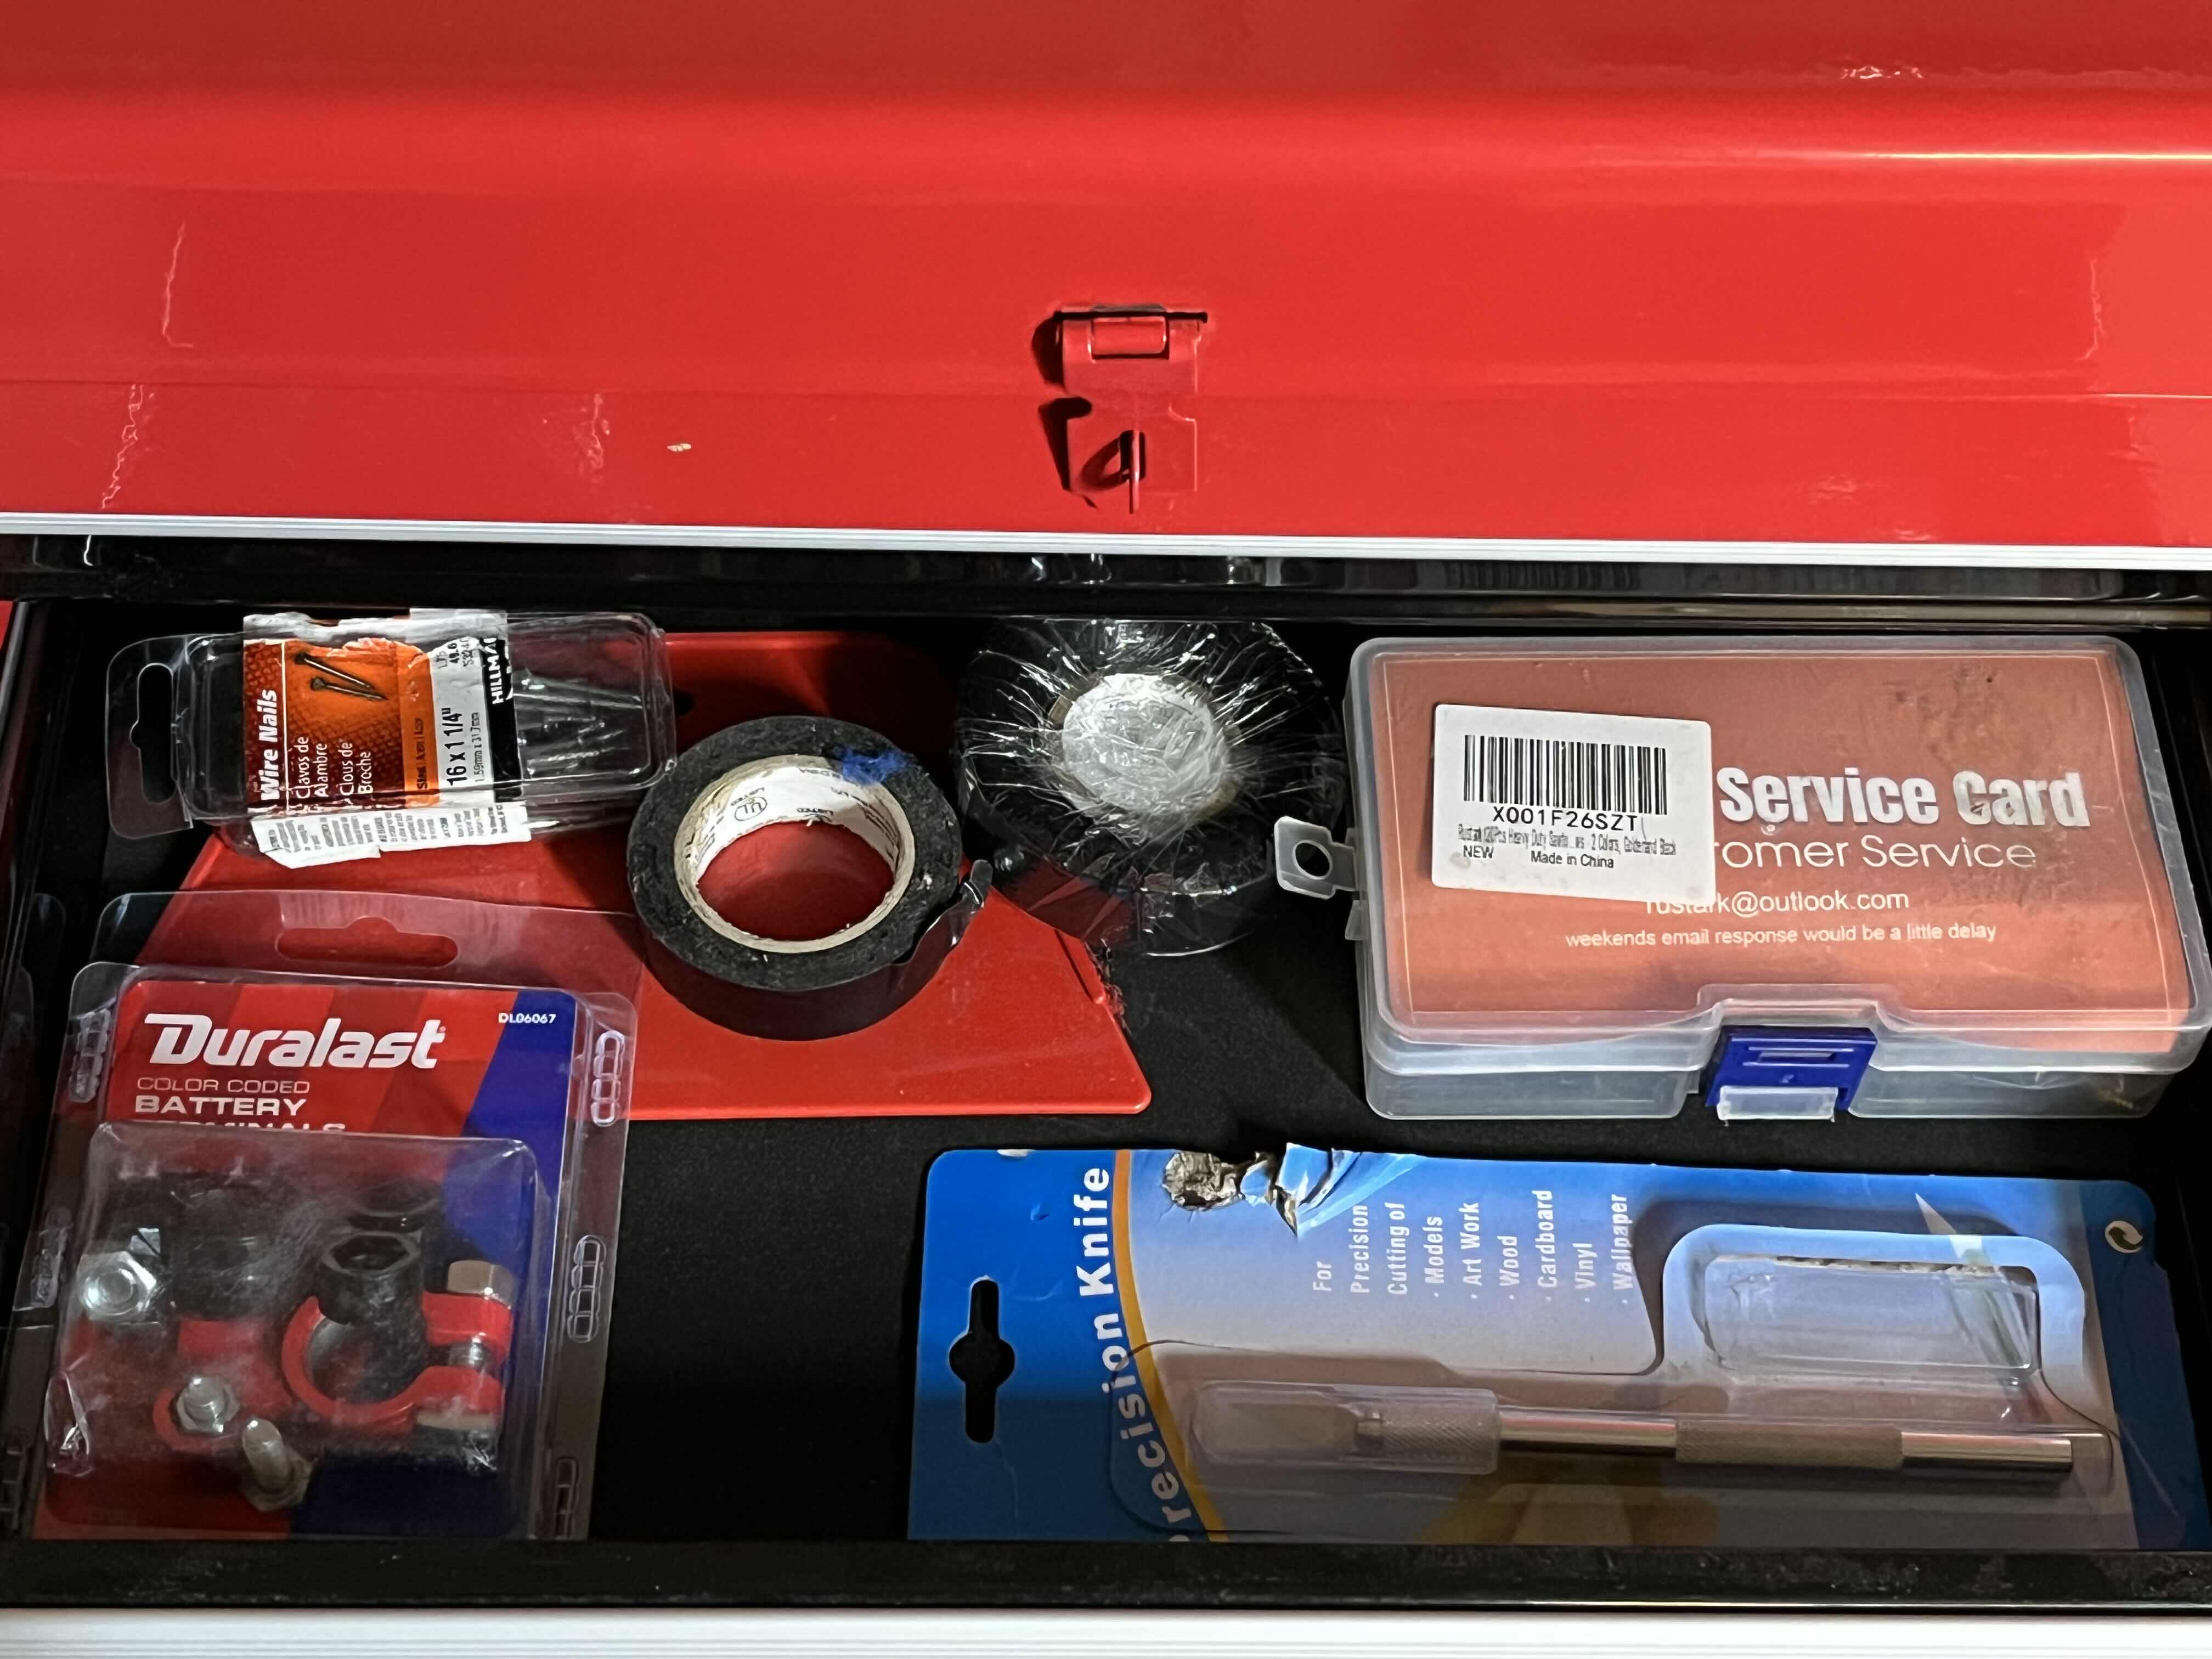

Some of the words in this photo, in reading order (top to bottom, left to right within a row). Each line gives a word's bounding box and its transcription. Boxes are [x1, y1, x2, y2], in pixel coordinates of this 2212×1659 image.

[256, 689, 278, 743] Nails
[441, 707, 464, 736] 1/4"
[294, 736, 309, 753] de
[337, 742, 353, 757] de
[444, 741, 465, 750] 1
[449, 752, 466, 762] x
[259, 749, 280, 800] Wire
[295, 756, 311, 799] Clavos
[312, 743, 329, 798] Alambre
[336, 761, 354, 796] Clous
[356, 751, 374, 794] Broche
[446, 765, 467, 786] 16
[1716, 767, 1940, 825] Service
[1953, 770, 2092, 828] Card
[1492, 805, 1638, 832] X001F26SZT
[1463, 845, 1494, 859] NEW
[1531, 850, 1562, 865] Made
[1567, 852, 1577, 865] in
[1581, 854, 1614, 868] China
[1714, 840, 1849, 868] omer
[1862, 834, 2037, 868] Service
[1565, 929, 1656, 947] weekends
[1661, 928, 1710, 945] email
[1714, 929, 1798, 949] response
[1803, 926, 1857, 942] would
[1862, 923, 1886, 941] be
[1889, 927, 1902, 941] a
[1906, 923, 1943, 940] little
[1948, 922, 1997, 943] delay
[143, 1012, 446, 1070] Duralast
[137, 1076, 219, 1092] COLOR
[227, 1079, 311, 1094] CODED
[134, 1094, 307, 1116] BATTERY
[1384, 1201, 1406, 1220] of
[1458, 1202, 1481, 1250] Work
[1073, 1167, 1115, 1297] Knife
[1347, 1205, 1370, 1294] Precision
[1422, 1216, 1444, 1284] Models
[1532, 1189, 1558, 1288] Cardboard
[1610, 1194, 1634, 1291] Wallpaper
[1312, 1261, 1333, 1292] For
[1386, 1225, 1410, 1295] Cutting
[1462, 1259, 1482, 1286] Art
[1497, 1235, 1520, 1286] Wood
[1572, 1242, 1598, 1289] Vinyl
